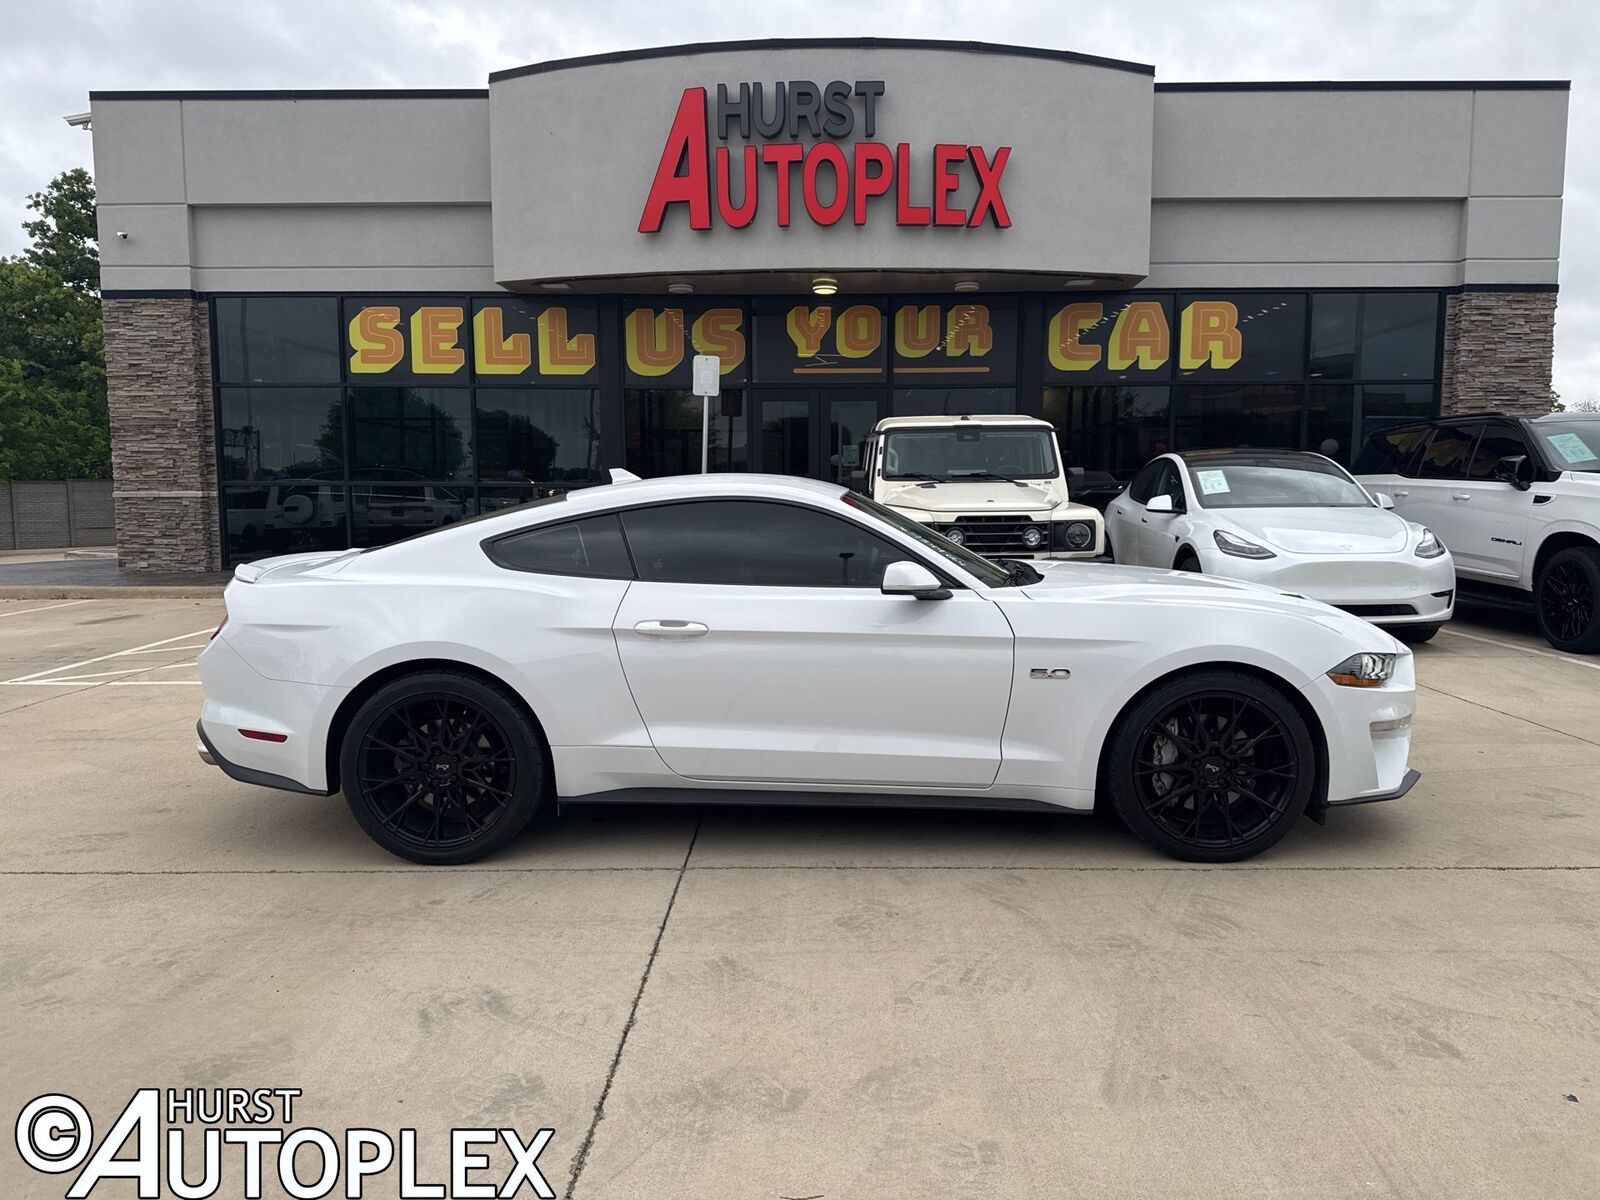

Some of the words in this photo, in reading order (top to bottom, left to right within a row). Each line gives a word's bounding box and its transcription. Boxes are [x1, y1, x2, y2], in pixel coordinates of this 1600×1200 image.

[717, 80, 885, 140] HURST
[637, 86, 1012, 233] AUTOPLEX
[349, 306, 596, 375] SELL
[625, 308, 746, 377] US
[786, 305, 993, 358] YOUR
[1048, 301, 1243, 371] CAR
[1490, 537, 1522, 546] DENALI
[1030, 668, 1071, 679] 5.0
